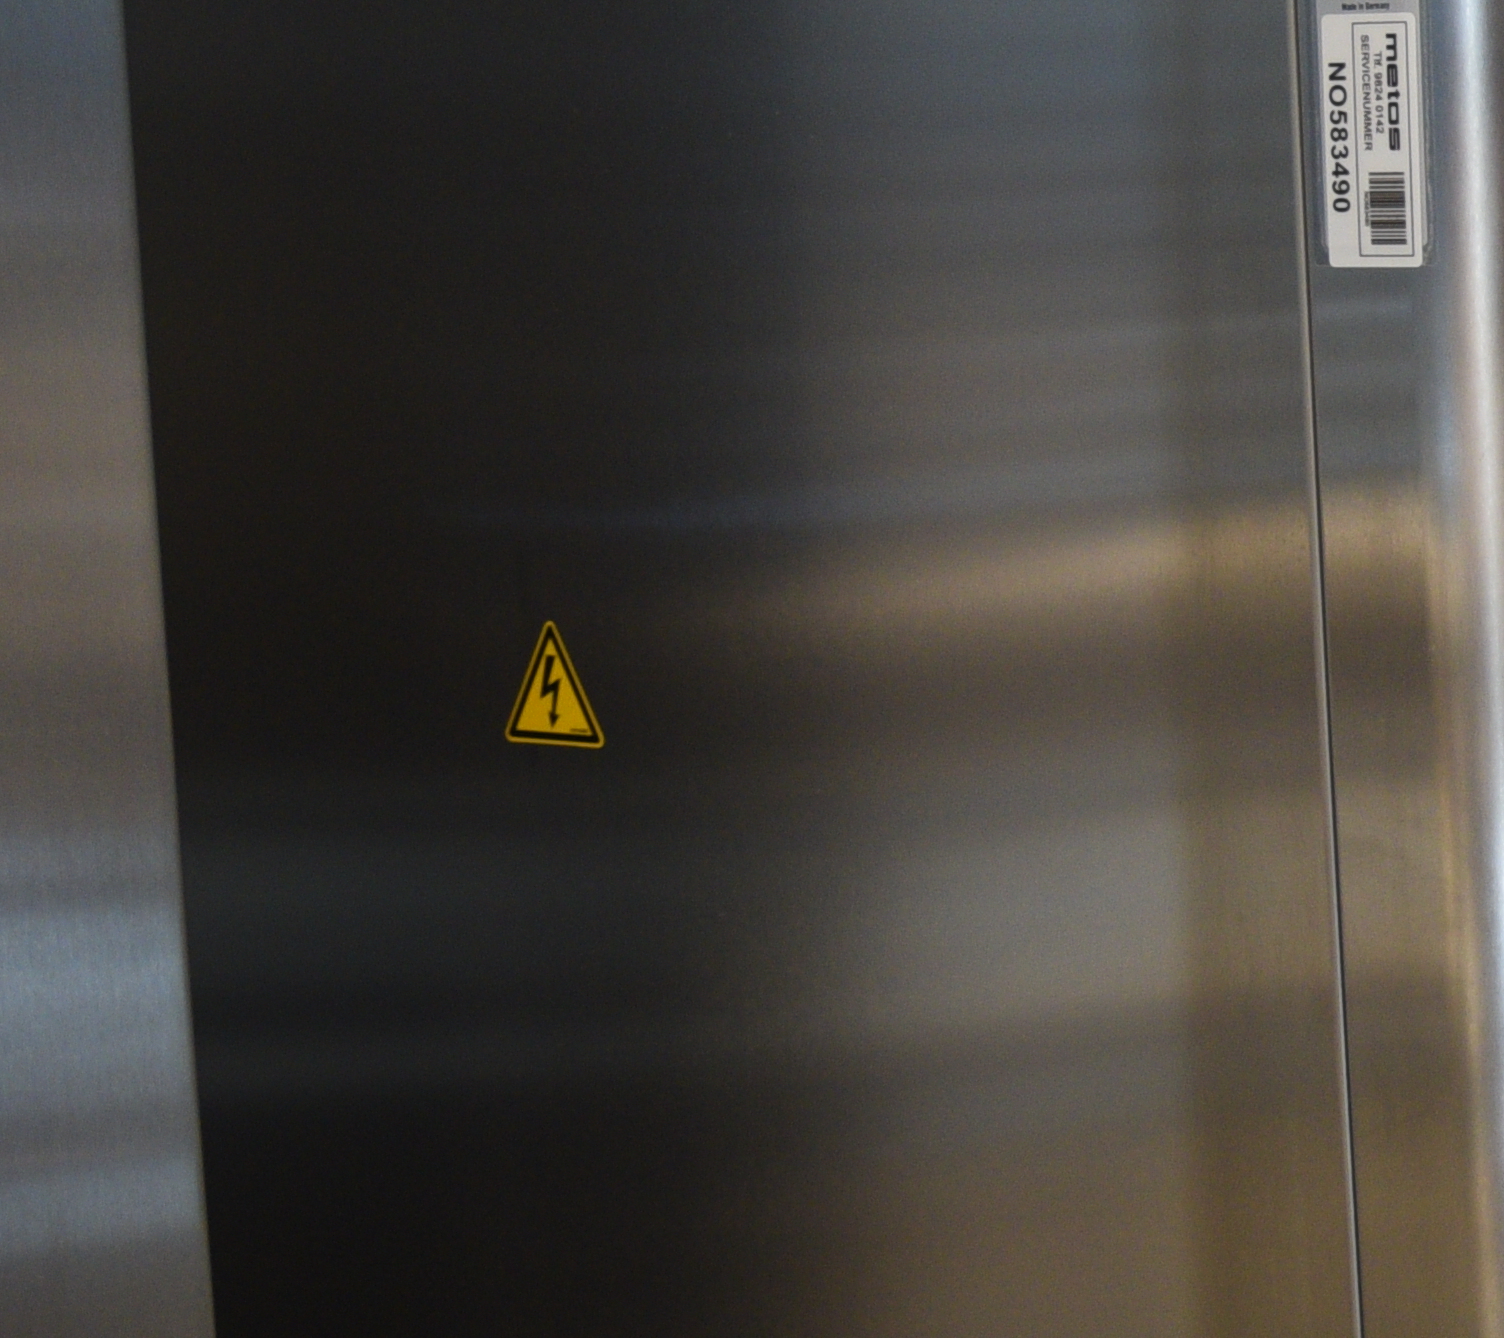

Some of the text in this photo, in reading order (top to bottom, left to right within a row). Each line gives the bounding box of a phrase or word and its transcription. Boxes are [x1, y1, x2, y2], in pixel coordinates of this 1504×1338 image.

[1328, 62, 1351, 213] NO583490
[1360, 34, 1374, 152] SERVICENUMMER
[1374, 72, 1384, 102] 9824
[1375, 104, 1385, 135] 0142
[1385, 32, 1401, 151] metos
